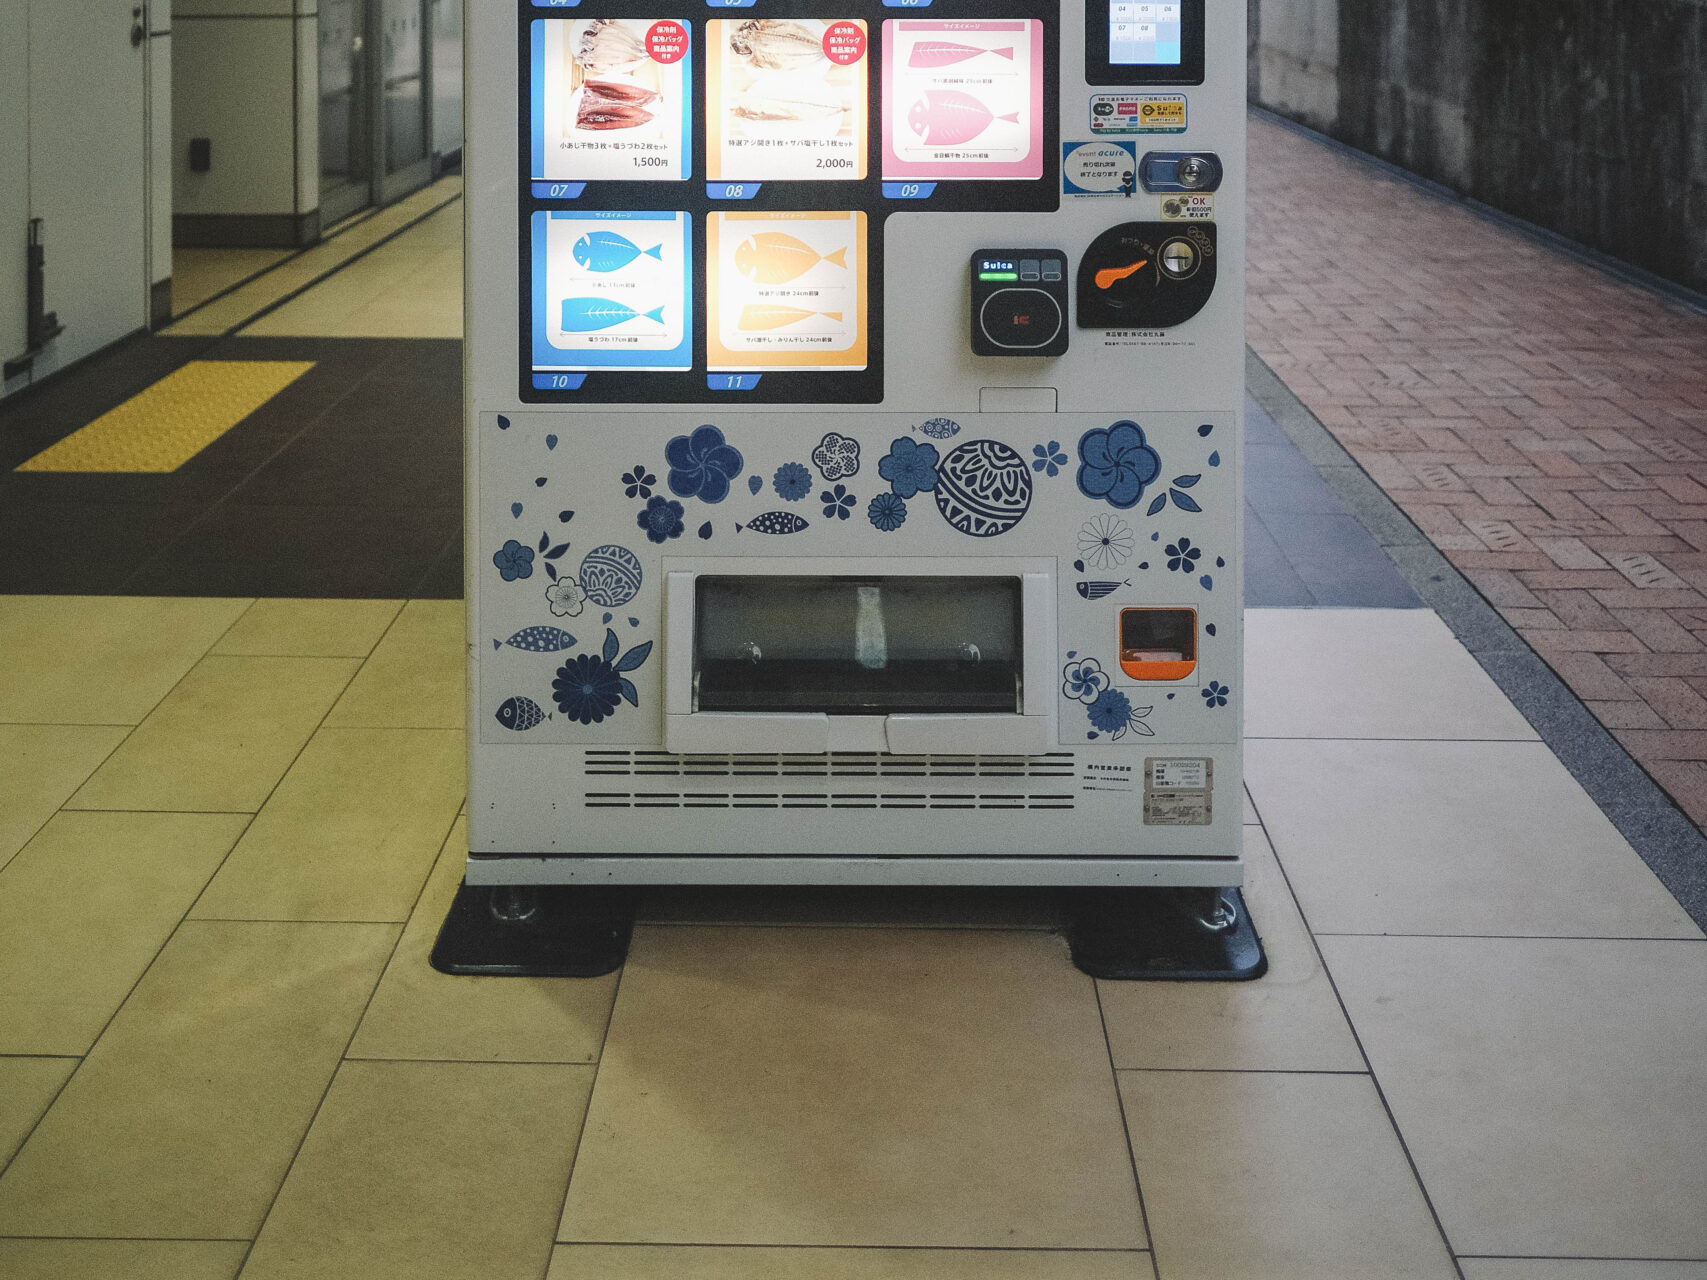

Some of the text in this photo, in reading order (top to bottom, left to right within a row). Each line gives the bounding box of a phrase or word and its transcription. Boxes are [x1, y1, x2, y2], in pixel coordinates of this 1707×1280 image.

[633, 157, 669, 167] 1,500円
[816, 159, 853, 169] 2,000円
[550, 185, 568, 197] 07
[726, 185, 743, 197] 08
[901, 185, 919, 197] 09
[983, 262, 1013, 270] Suica
[552, 376, 568, 388] 10
[728, 376, 743, 388] 11
